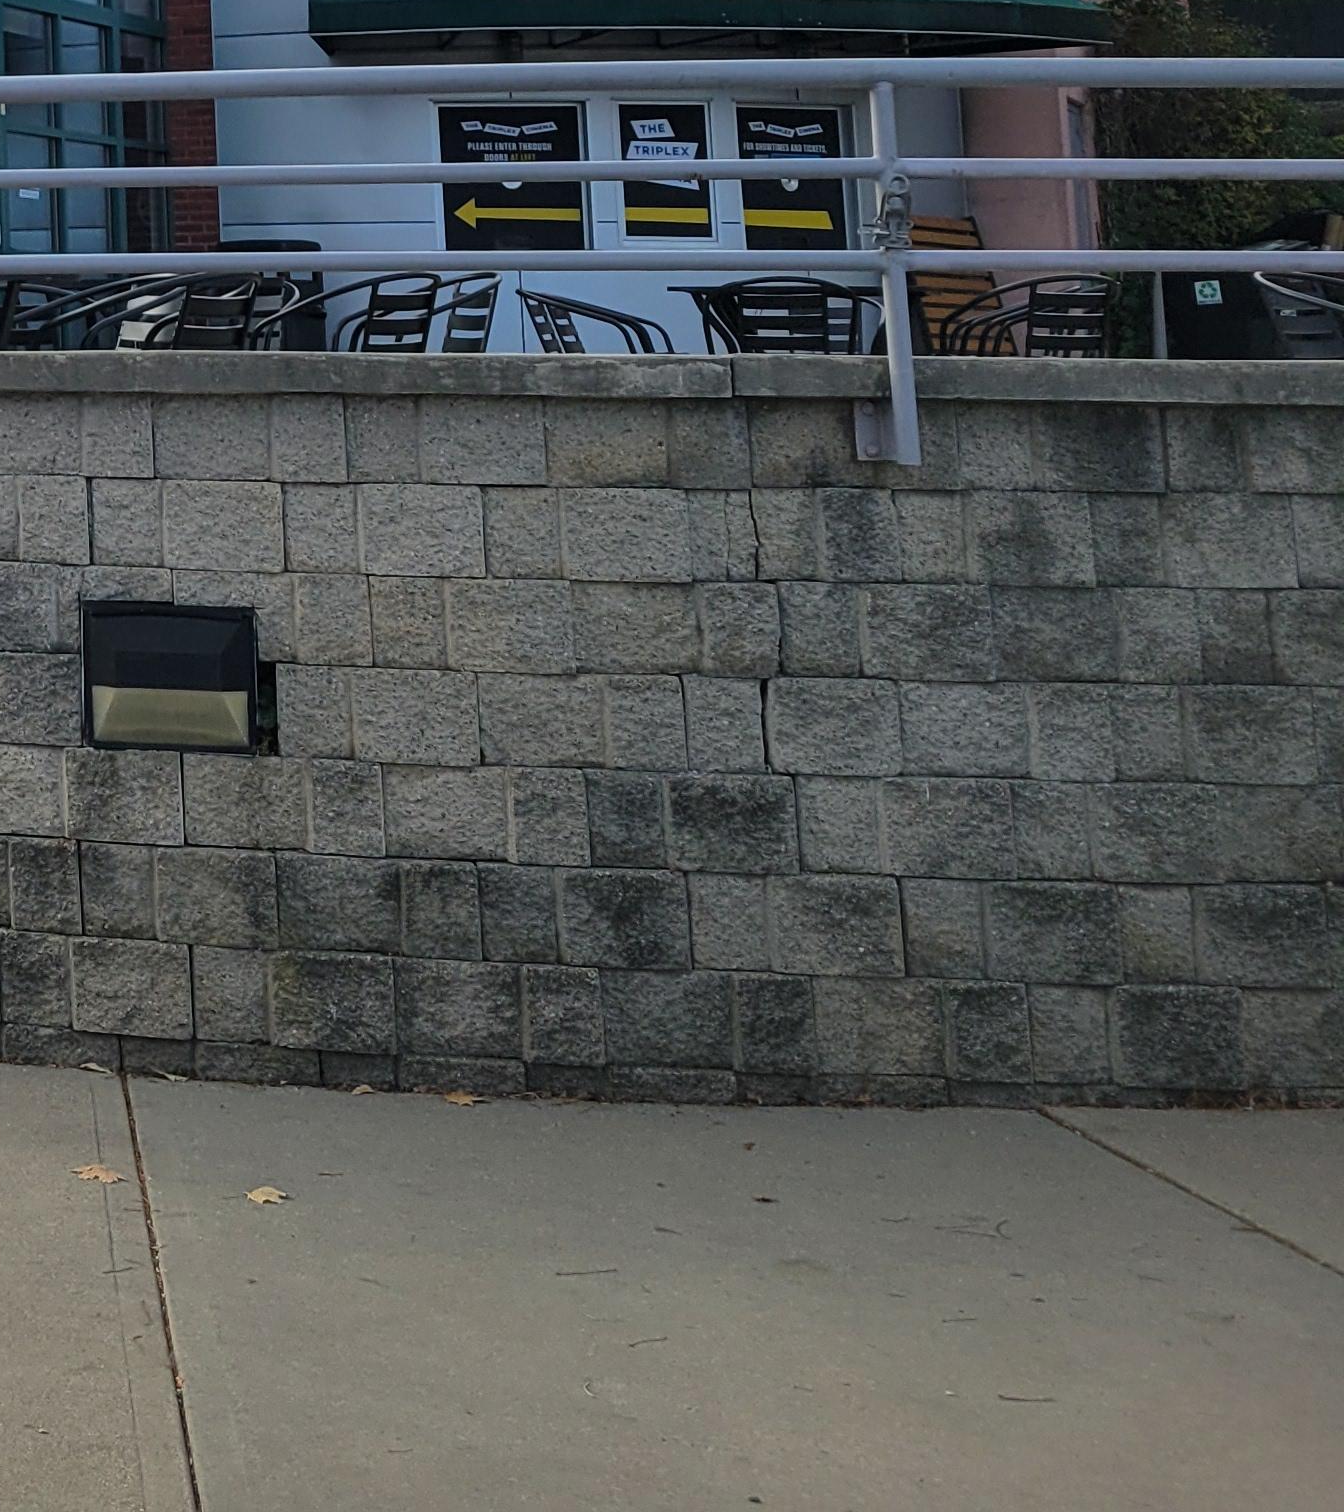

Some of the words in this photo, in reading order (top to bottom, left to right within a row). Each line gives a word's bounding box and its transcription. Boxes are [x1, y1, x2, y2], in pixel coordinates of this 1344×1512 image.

[640, 123, 665, 134] THE
[467, 142, 493, 151] PLEASE
[634, 145, 690, 156] TRIPLEX
